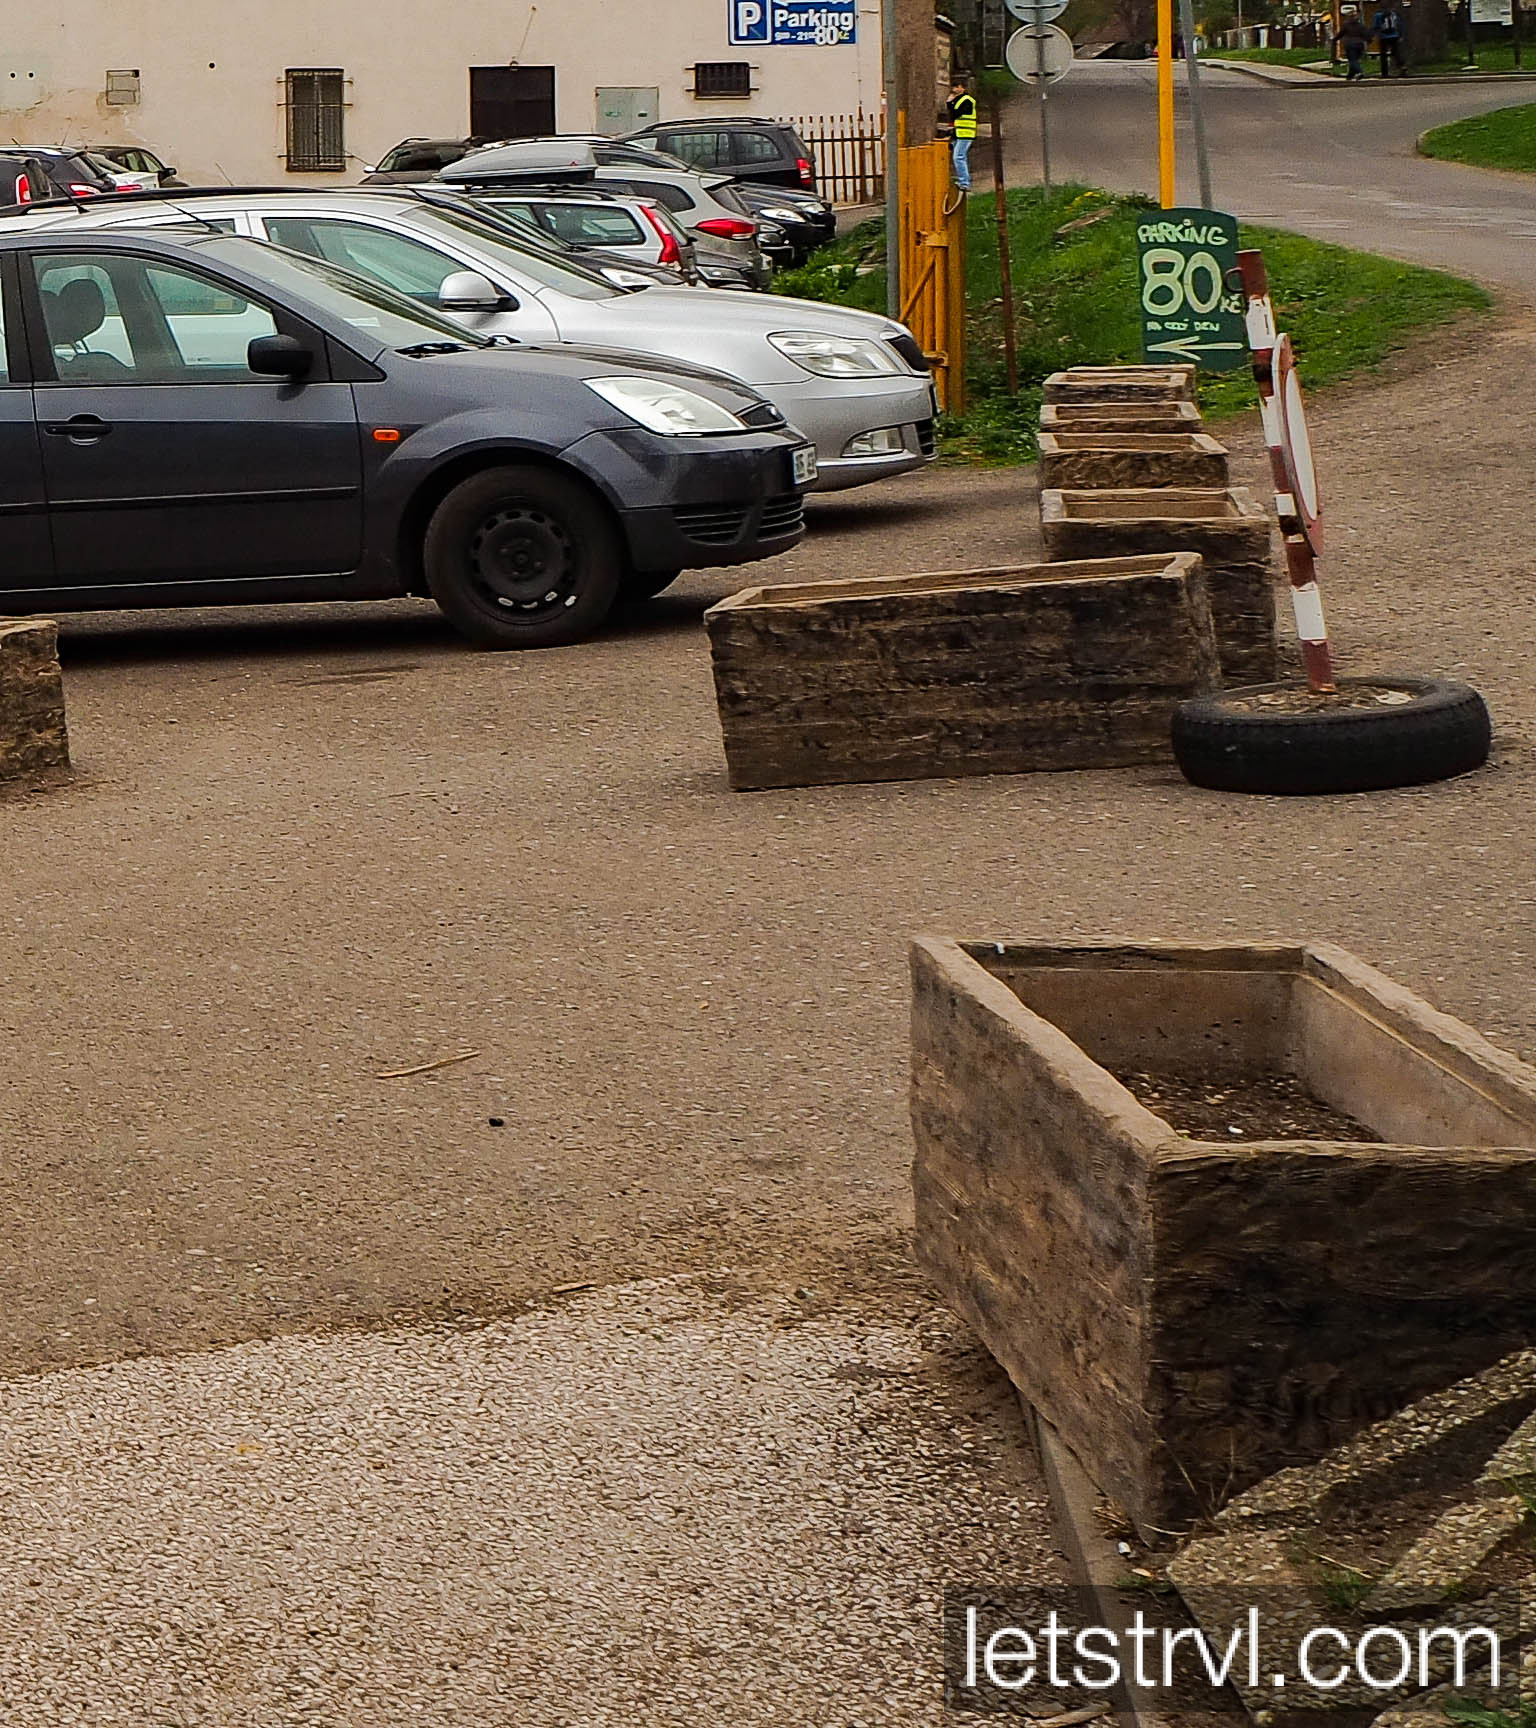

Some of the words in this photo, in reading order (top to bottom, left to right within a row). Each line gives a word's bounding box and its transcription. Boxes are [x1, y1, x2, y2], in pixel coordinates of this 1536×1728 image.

[737, 1, 761, 37] P
[774, 8, 854, 31] Parking
[815, 25, 840, 46] 80
[1142, 248, 1223, 316] 80
